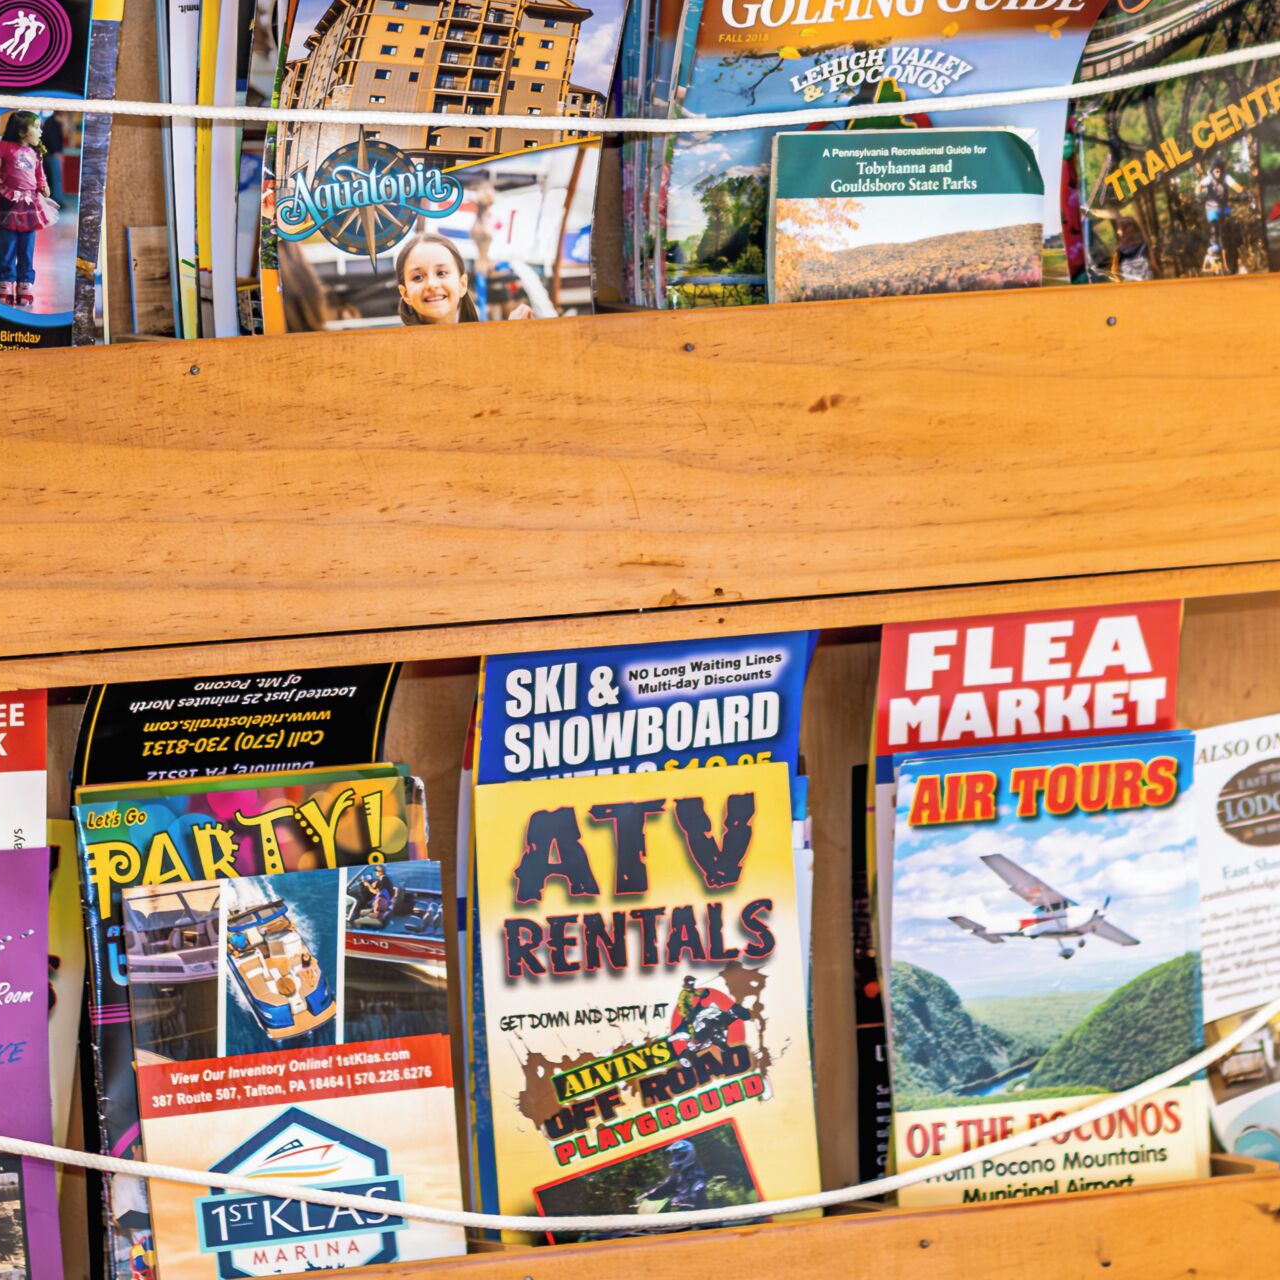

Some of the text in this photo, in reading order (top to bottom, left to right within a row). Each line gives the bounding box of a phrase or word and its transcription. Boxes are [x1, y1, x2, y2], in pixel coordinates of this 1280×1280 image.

[822, 145, 988, 158] A Pennsylvania Recreational Guide for
[856, 159, 953, 178] Tobyhanna and
[1104, 138, 1194, 202] TRAIL
[277, 162, 462, 238] Aquatopia
[831, 176, 978, 193] Gouldsboro State Parks
[904, 615, 1153, 691] FLEA
[129, 686, 357, 713] Located just 25 minutes North
[505, 662, 619, 718] SKI &
[887, 677, 1167, 746] MARKET
[141, 729, 325, 756] Call (570) 730-8131
[143, 710, 331, 732] www.ridelosttrails.com
[503, 691, 780, 773] SNOWBOARD
[907, 770, 997, 828] AIR
[1009, 755, 1179, 818] TOURS
[514, 792, 756, 905] ATV
[503, 899, 776, 977] RENTALS
[152, 1066, 432, 1108] 387 Route 507, Tafton, PA 18464 570.226.6276
[171, 1049, 410, 1085] View Our Inventory Online! 1stKlas.com
[562, 1040, 672, 1098] ALVIN'S
[554, 1073, 765, 1167] PLAYGROUND
[982, 1144, 1168, 1179] Pocono Mountains
[253, 1240, 360, 1265] MARINA
